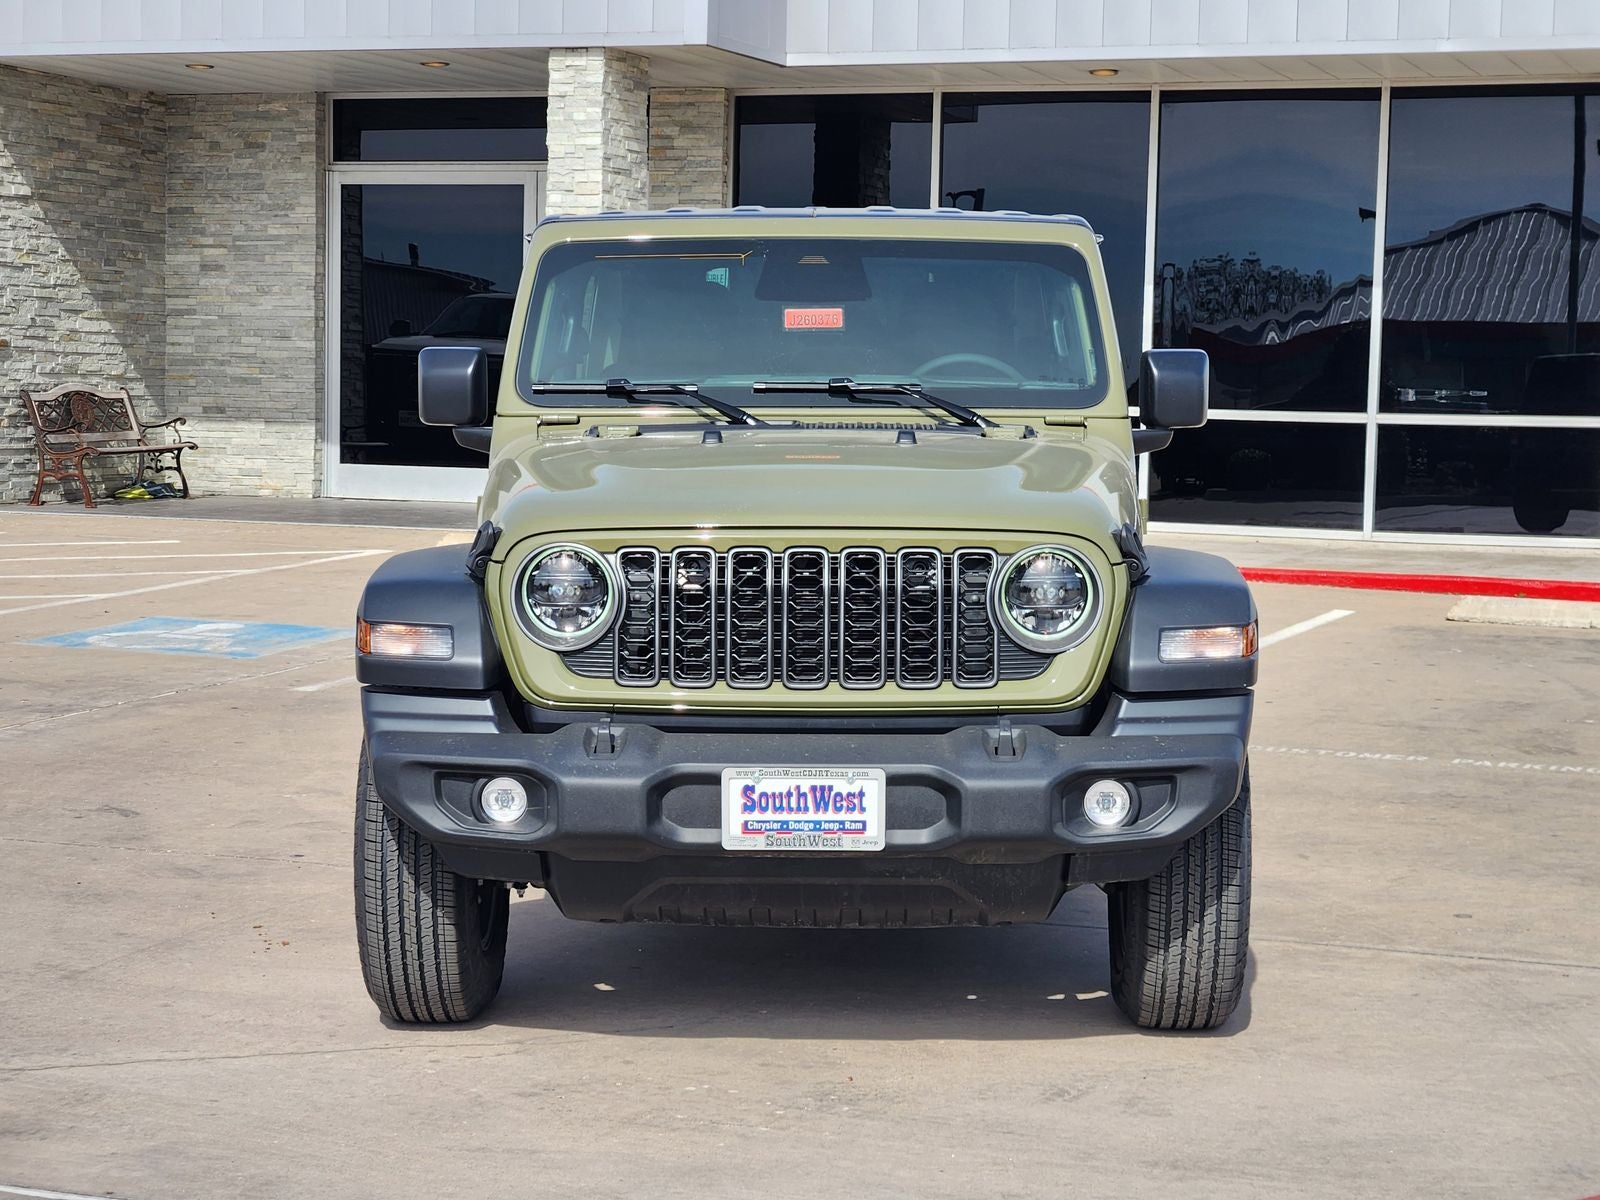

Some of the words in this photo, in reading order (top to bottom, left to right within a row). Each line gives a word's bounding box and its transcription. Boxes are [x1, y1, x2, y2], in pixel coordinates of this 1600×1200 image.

[789, 314, 839, 326] J260376
[735, 769, 869, 778] wwwSouthWestCDJRTexascom
[741, 784, 866, 814] SouthWest
[747, 821, 781, 831] Chrysler
[788, 821, 814, 831] Dodge
[821, 821, 839, 831] Jeep
[844, 821, 863, 830] Ram
[765, 834, 843, 847] SouthWest
